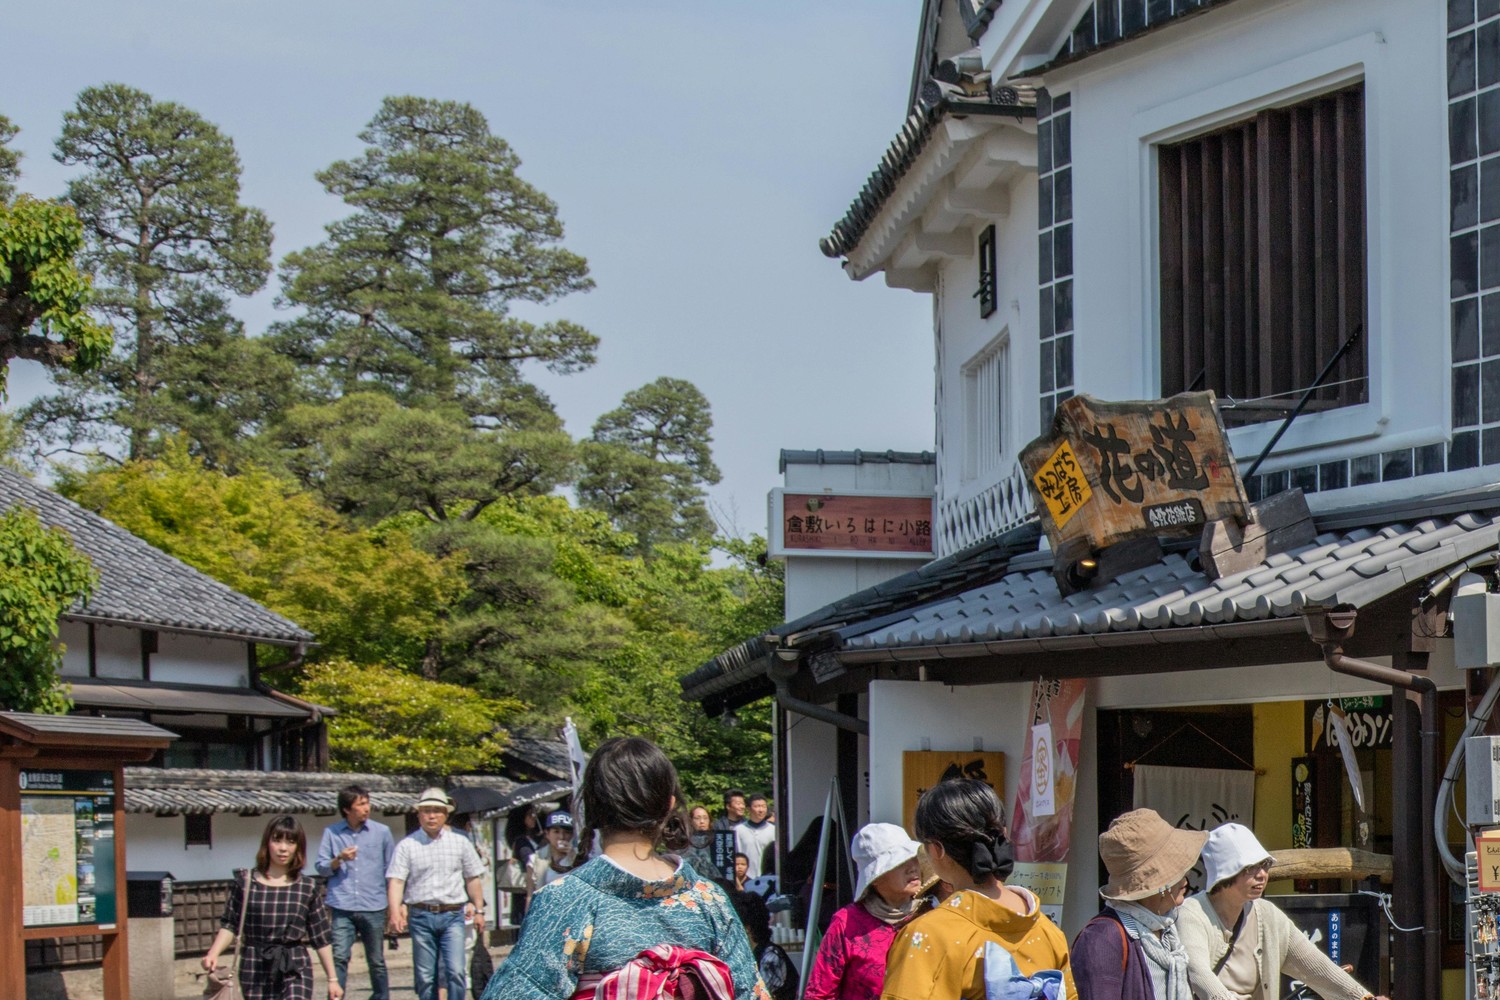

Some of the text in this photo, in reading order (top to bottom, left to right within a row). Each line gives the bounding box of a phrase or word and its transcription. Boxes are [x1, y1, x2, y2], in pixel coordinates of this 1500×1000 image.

[1039, 448, 1076, 499] みつばち
[1082, 408, 1210, 506] 花の道
[1053, 476, 1083, 516] 工房
[787, 514, 931, 536] 倉敷いろはに小路
